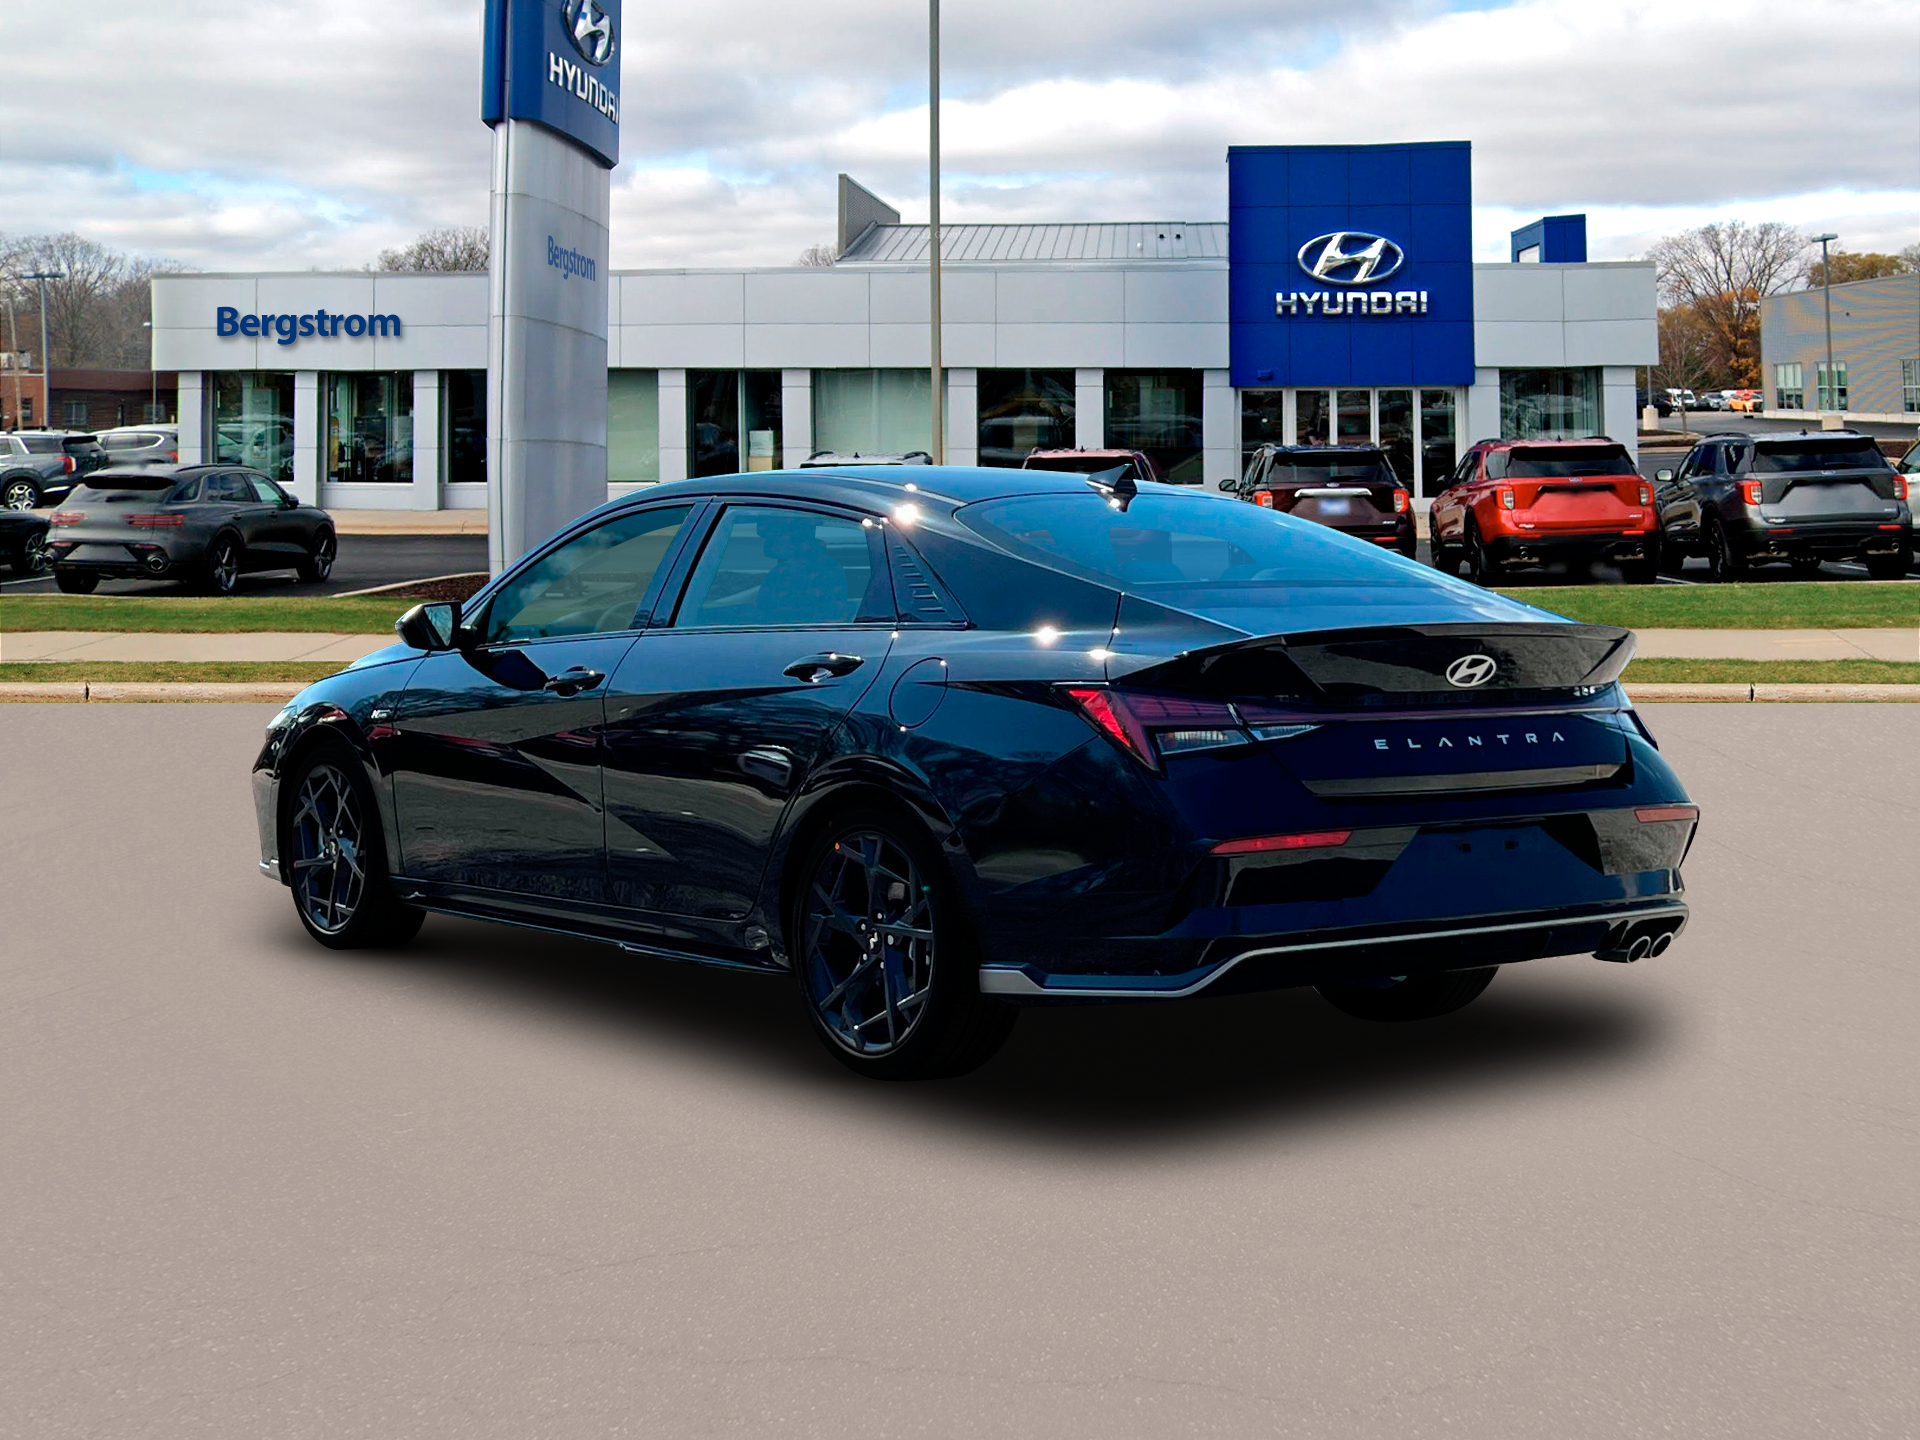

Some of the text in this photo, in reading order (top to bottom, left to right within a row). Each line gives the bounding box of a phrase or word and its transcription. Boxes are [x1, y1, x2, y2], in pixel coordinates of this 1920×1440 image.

[548, 51, 619, 124] HYUNDAI
[547, 234, 596, 282] Bergstrom
[1275, 291, 1428, 315] HYUNDAI
[216, 306, 402, 346] Bergstrom
[1374, 732, 1564, 749] ELANTRA
